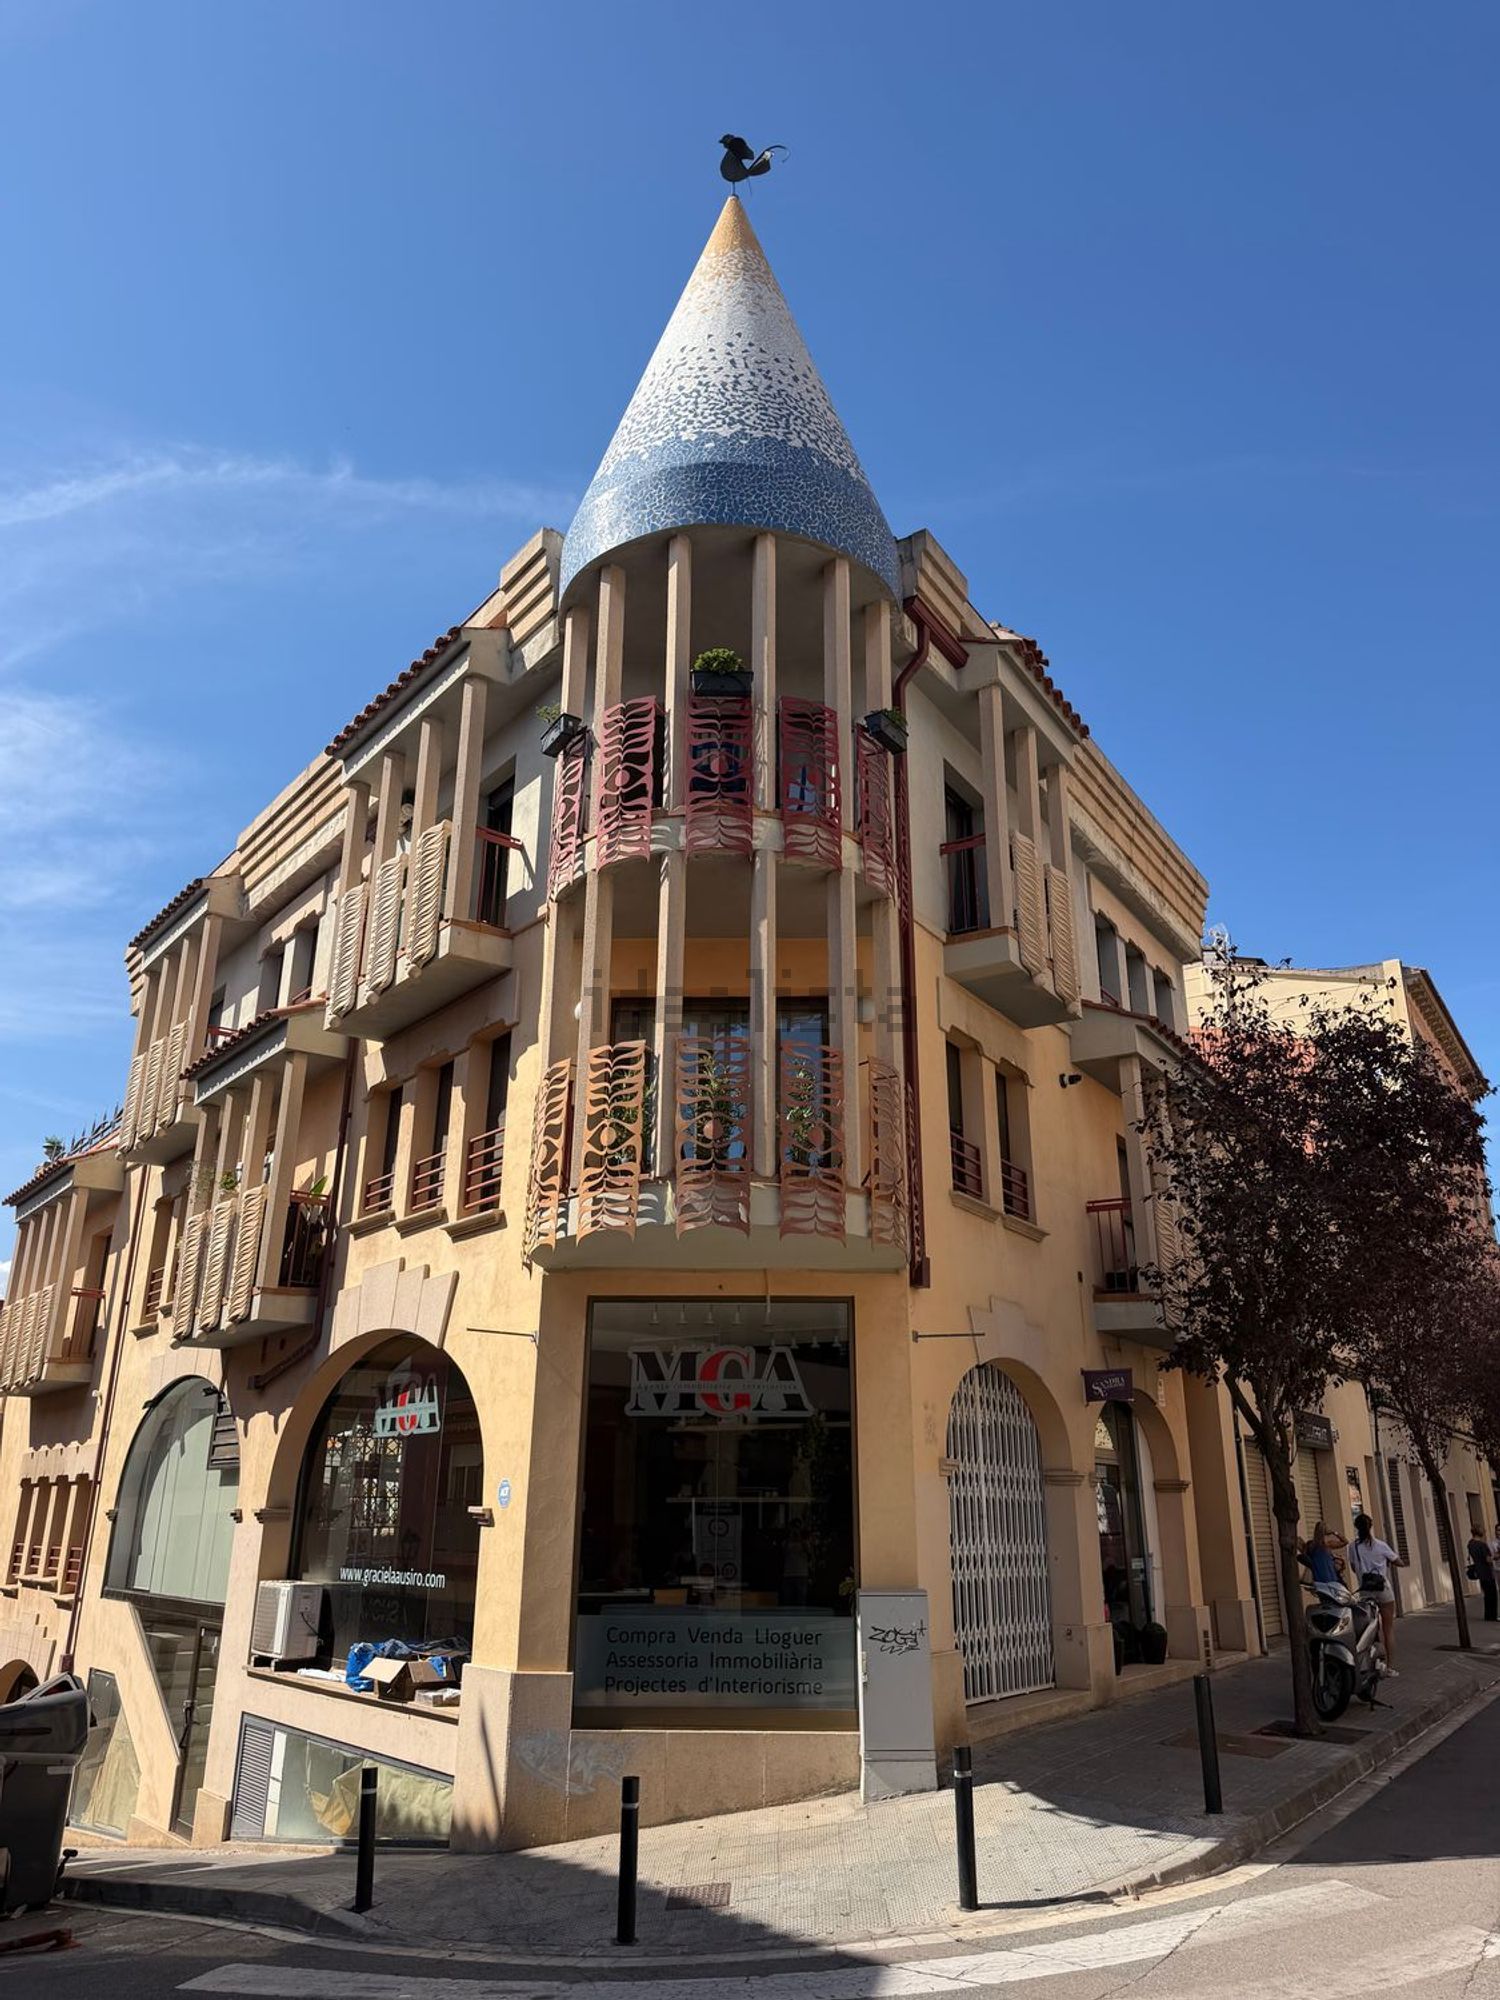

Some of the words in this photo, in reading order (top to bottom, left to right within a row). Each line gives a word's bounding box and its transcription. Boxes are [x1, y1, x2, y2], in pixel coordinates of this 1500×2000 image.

[629, 1349, 810, 1412] MCA
[339, 1565, 446, 1589] www.gracielaausiro.com
[606, 1627, 676, 1647] Compra
[688, 1627, 743, 1644] Venda
[755, 1627, 823, 1649] Lloguer
[606, 1651, 699, 1668] Assessoria
[710, 1651, 823, 1670] Immobiliària
[604, 1676, 687, 1696] Projectes
[698, 1676, 823, 1695] d'Interiorisme
